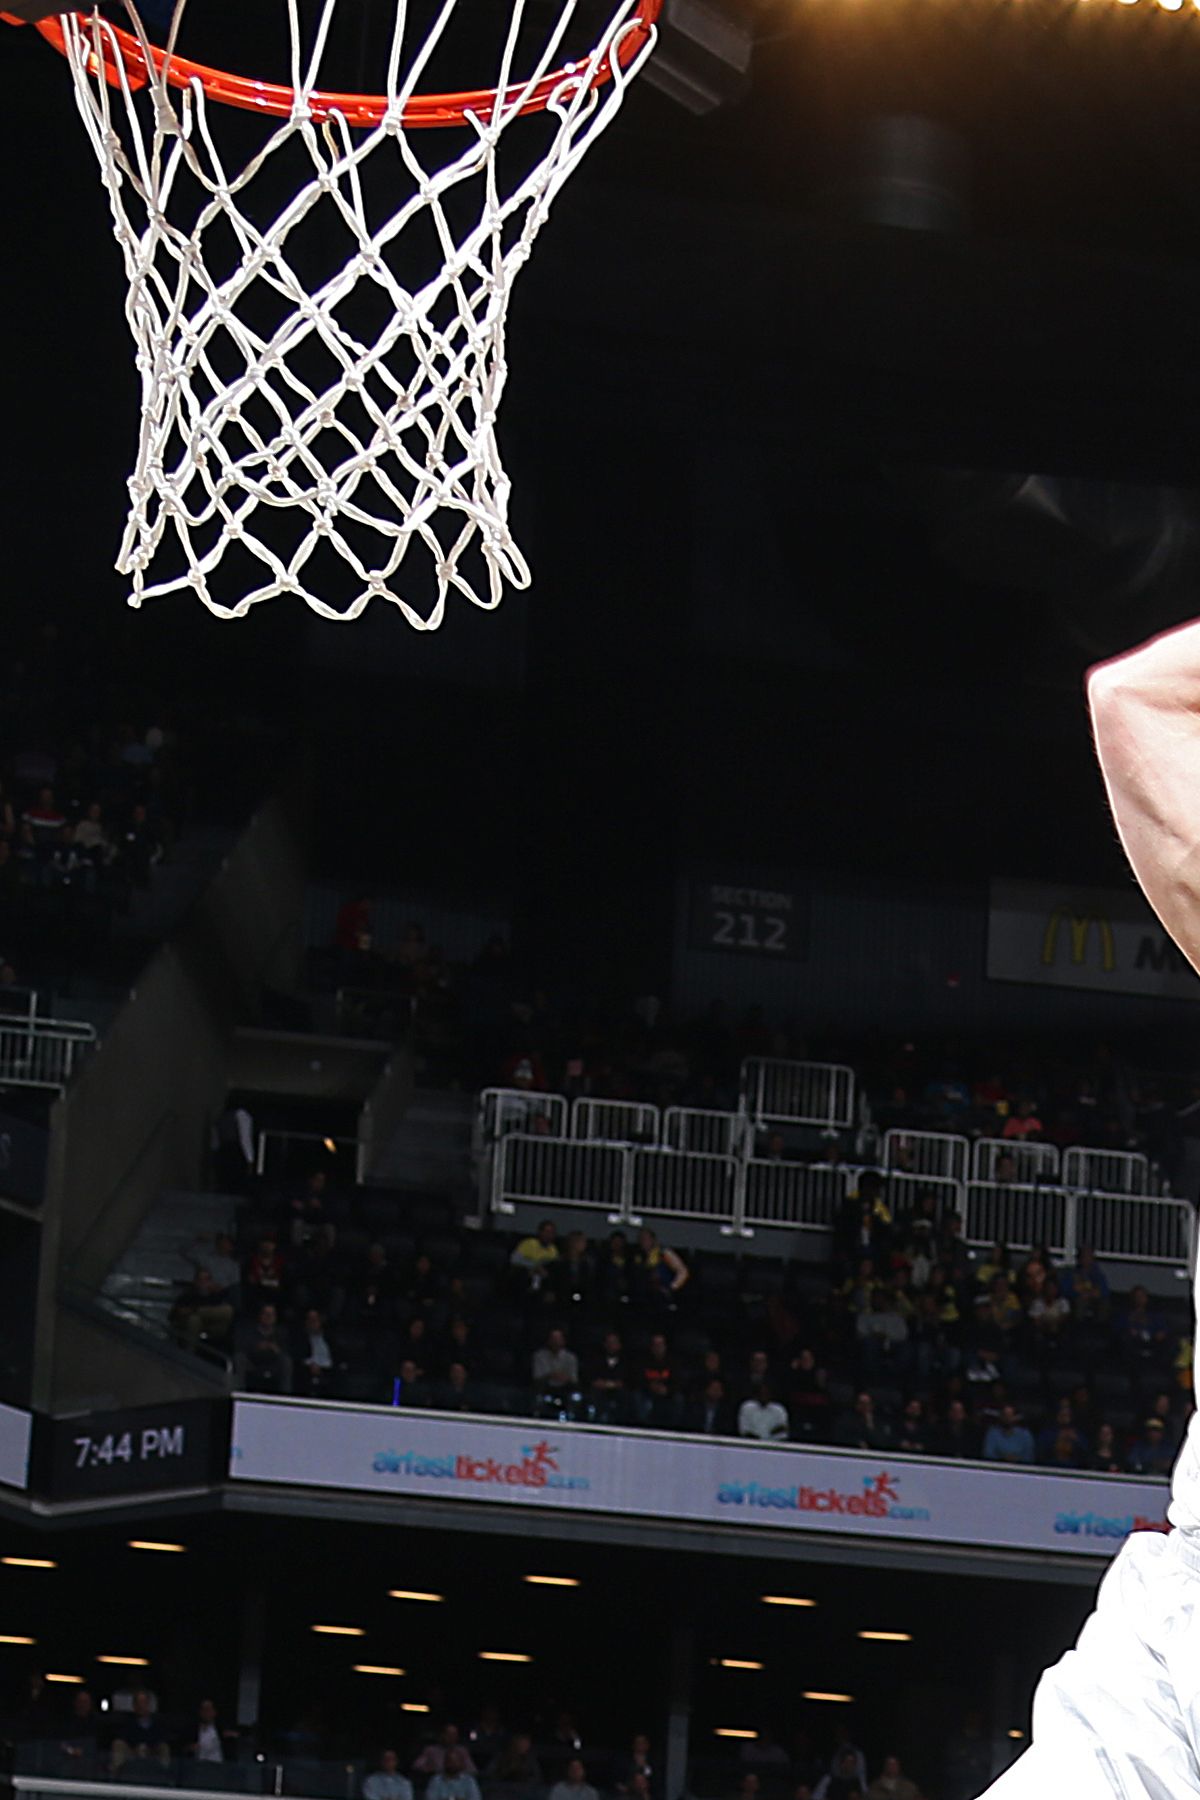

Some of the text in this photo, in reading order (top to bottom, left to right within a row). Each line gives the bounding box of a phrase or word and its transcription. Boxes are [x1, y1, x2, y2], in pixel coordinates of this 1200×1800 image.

[713, 912, 787, 950] 212
[72, 1425, 182, 1467] 7:44 PM
